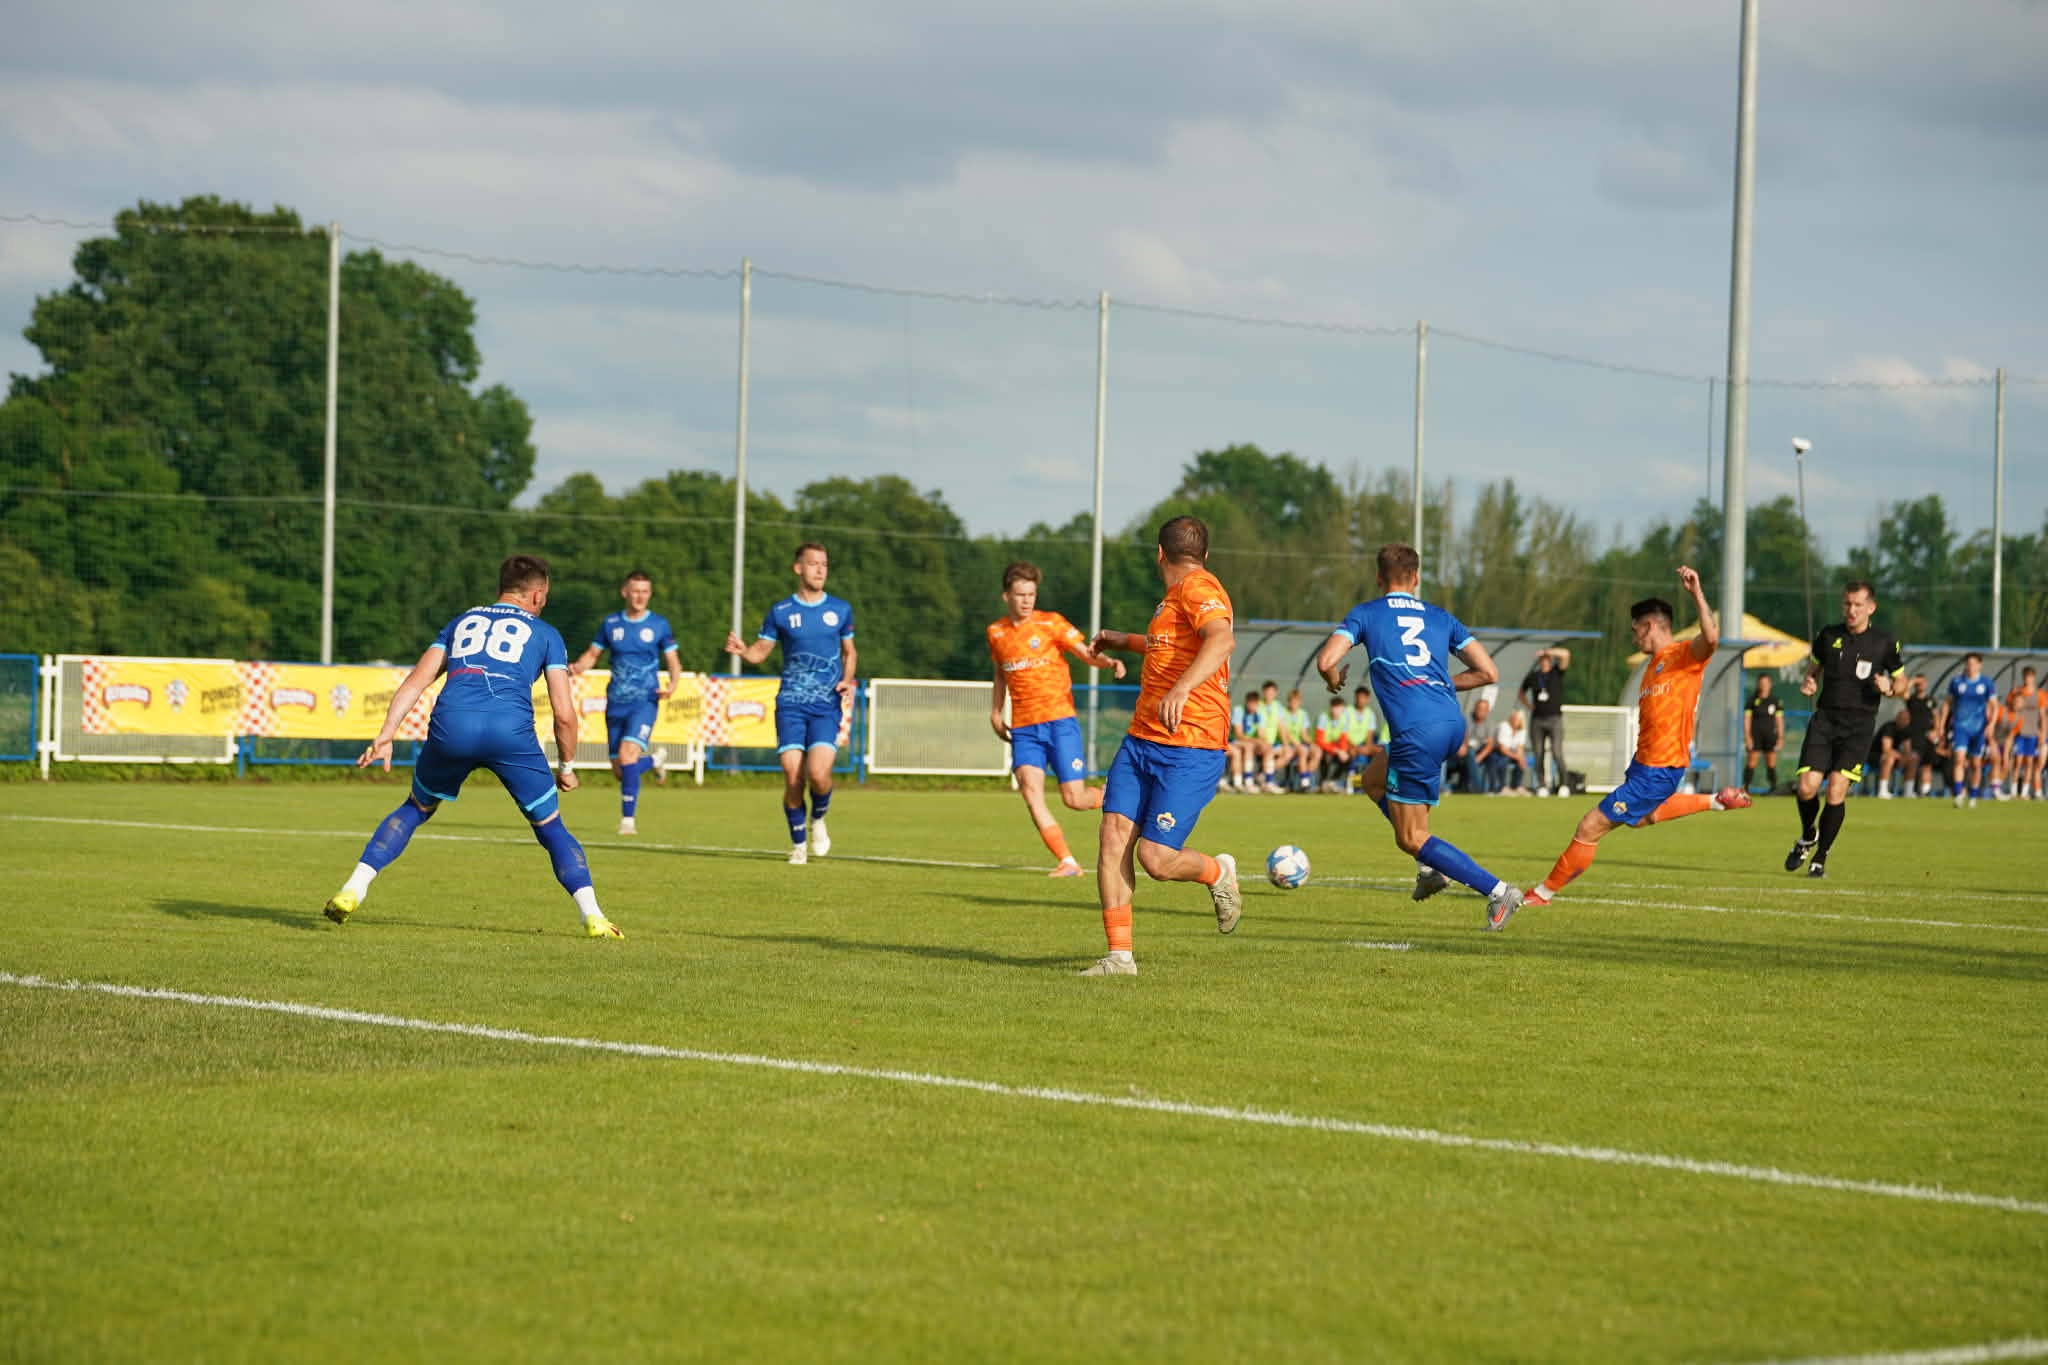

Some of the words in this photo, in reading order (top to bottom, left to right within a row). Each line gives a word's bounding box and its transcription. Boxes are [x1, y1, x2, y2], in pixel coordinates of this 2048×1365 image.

[451, 614, 533, 664] 88
[788, 612, 802, 629] 11
[1397, 615, 1432, 667] 3
